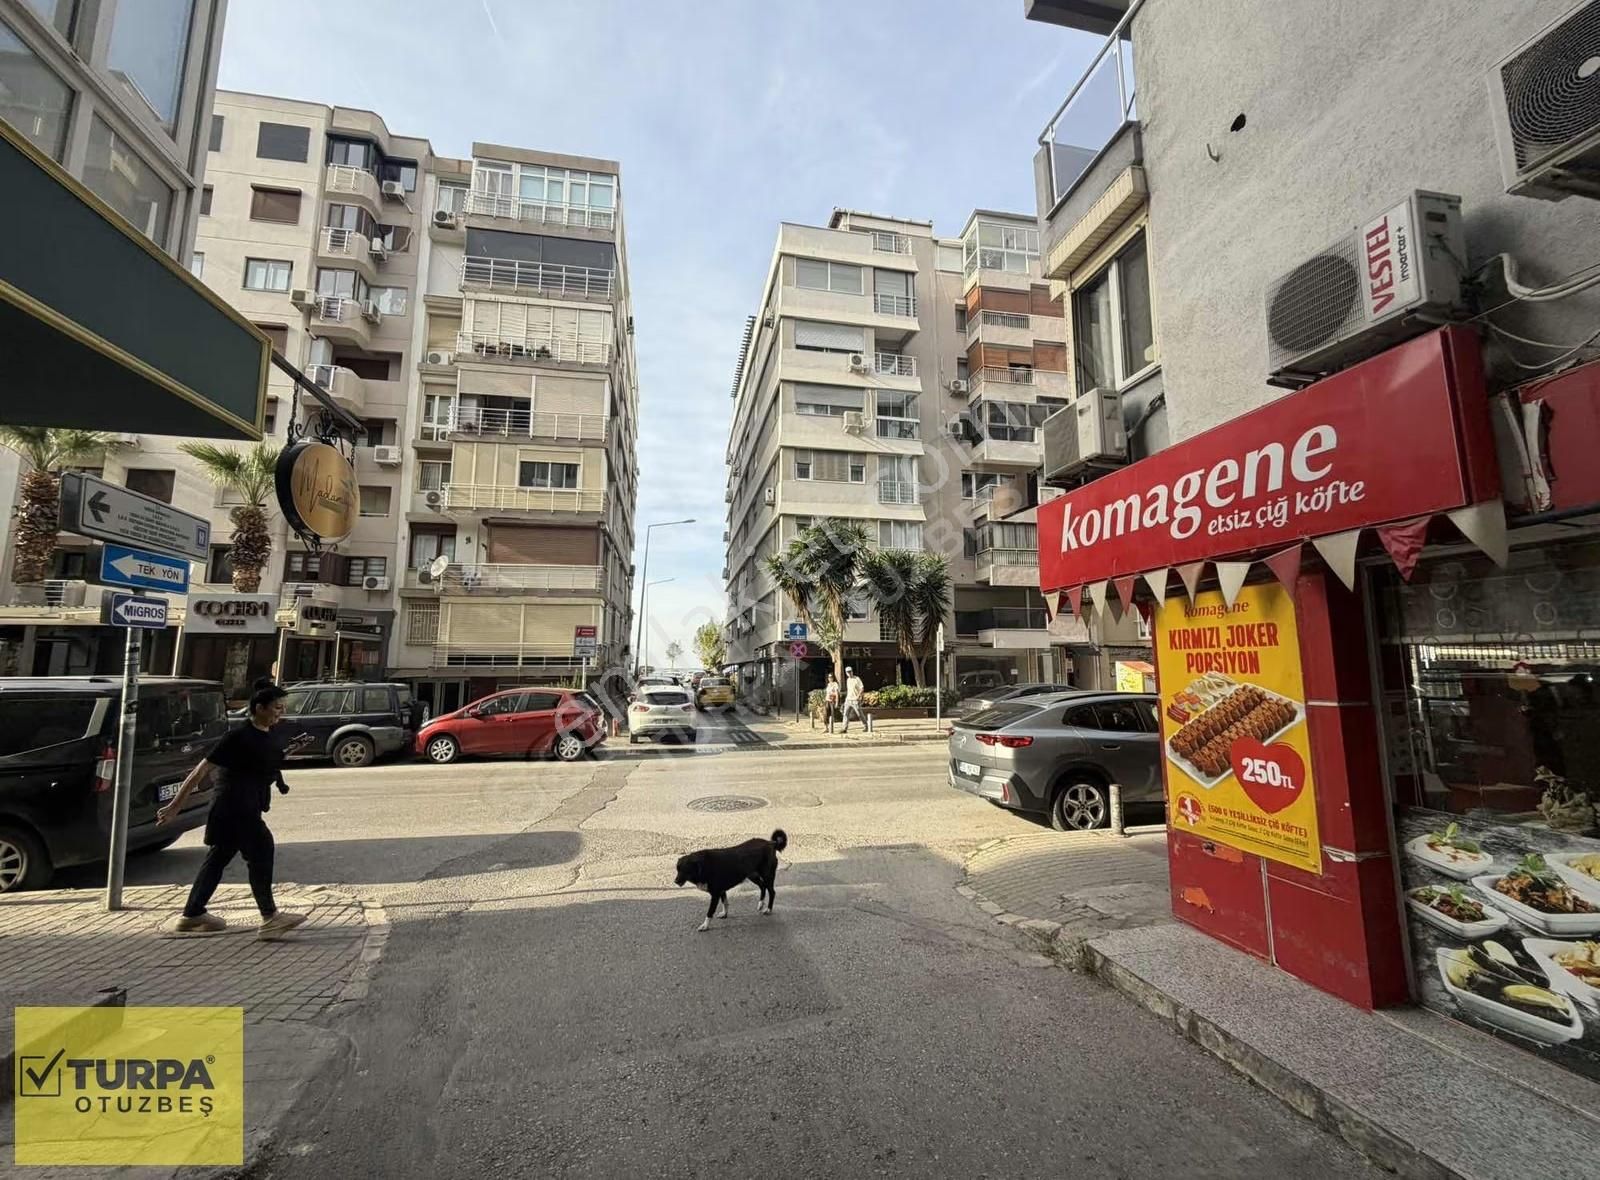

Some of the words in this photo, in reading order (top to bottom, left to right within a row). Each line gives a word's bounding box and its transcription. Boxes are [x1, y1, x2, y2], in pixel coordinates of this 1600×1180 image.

[1366, 216, 1395, 314] VESTEL
[1061, 424, 1338, 553] komagene
[1207, 509, 1252, 537] etsiz
[1255, 496, 1288, 528] çiğ
[1295, 480, 1366, 514] köfte
[138, 564, 156, 576] TEK
[162, 567, 179, 580] YÖN
[1169, 626, 1221, 650] KIRMIZI
[1226, 622, 1279, 648] JOKER
[1186, 646, 1260, 674] PORSİYON
